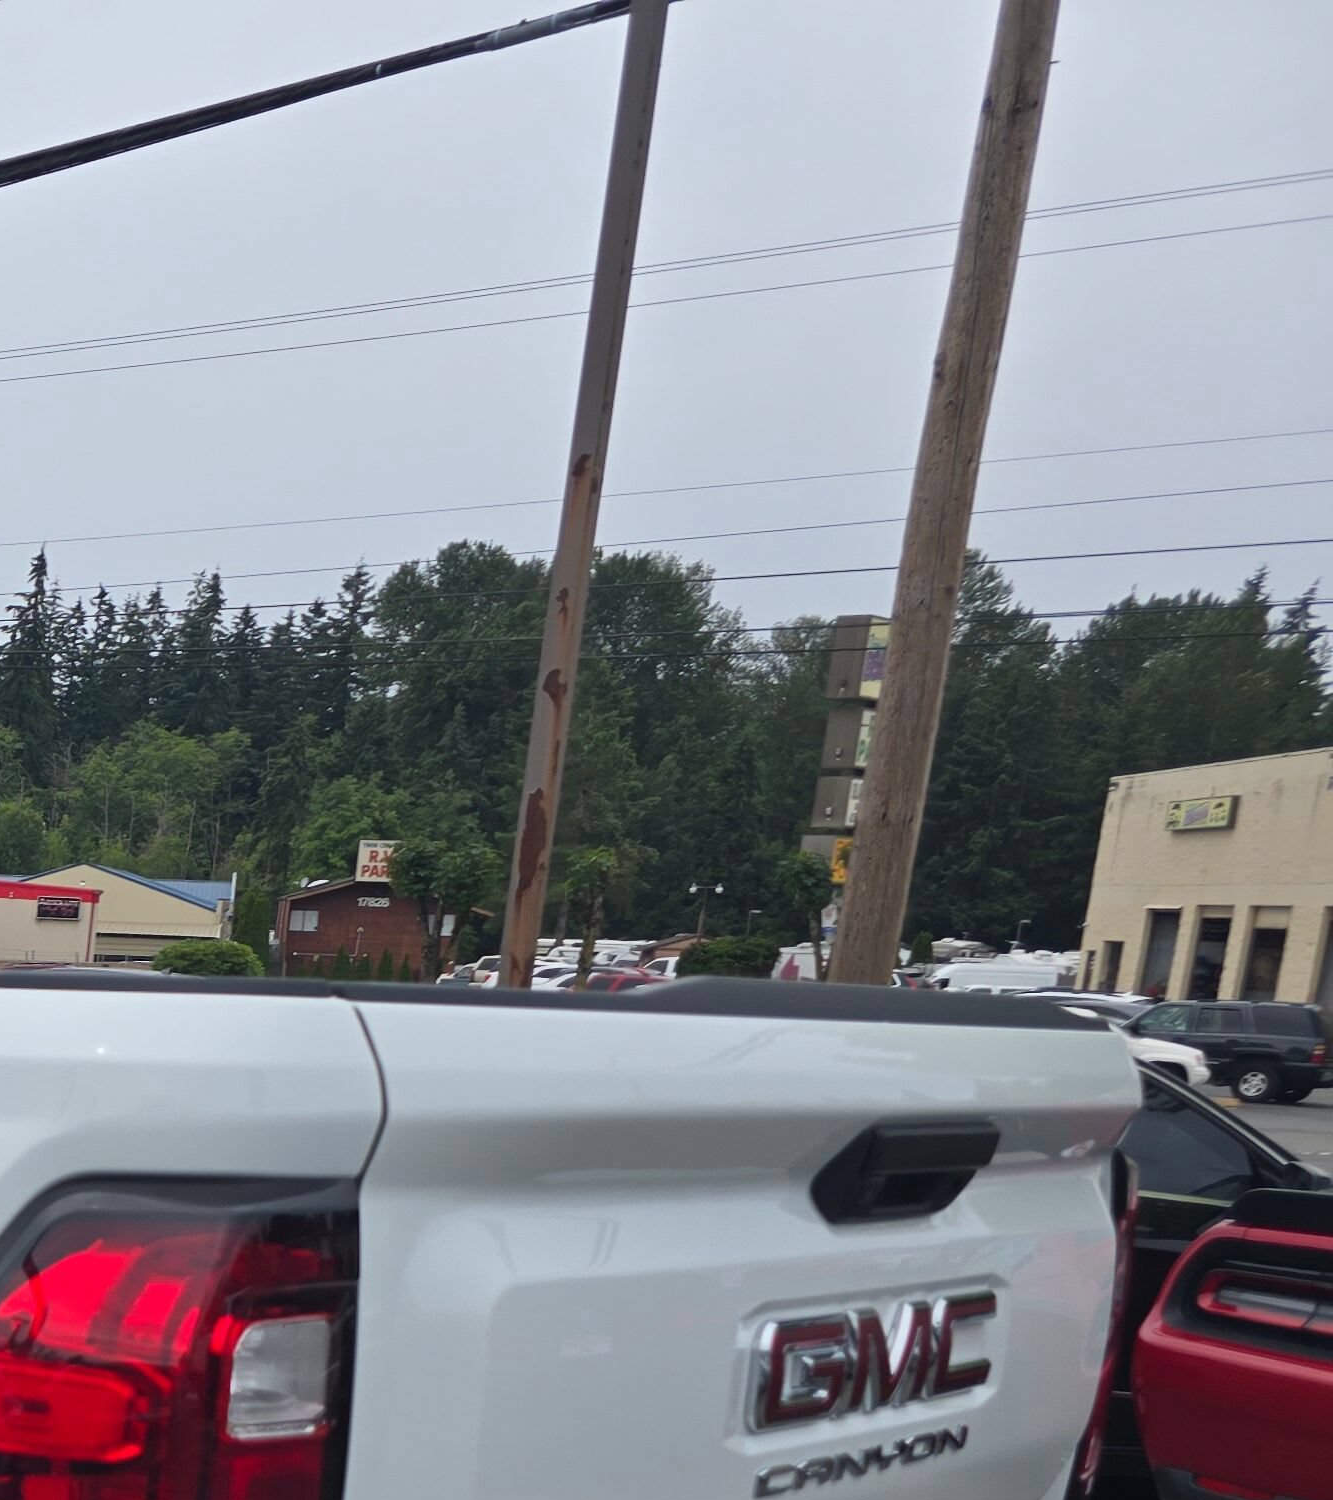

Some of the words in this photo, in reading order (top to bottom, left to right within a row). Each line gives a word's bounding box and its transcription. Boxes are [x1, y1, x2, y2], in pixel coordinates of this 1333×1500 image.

[361, 865, 390, 878] PAR
[743, 1289, 998, 1435] GMC
[753, 1424, 969, 1499] CANYON
